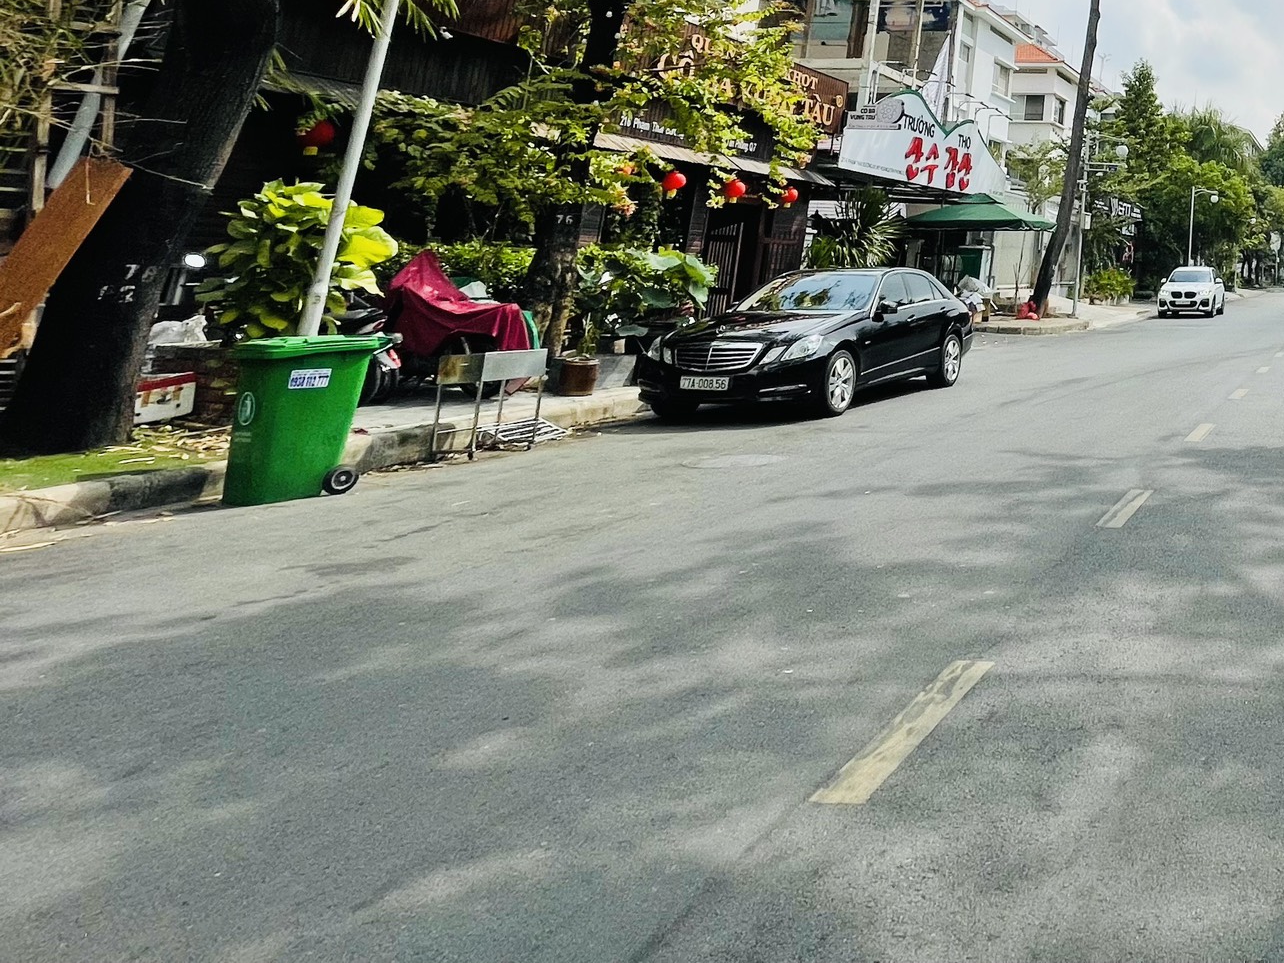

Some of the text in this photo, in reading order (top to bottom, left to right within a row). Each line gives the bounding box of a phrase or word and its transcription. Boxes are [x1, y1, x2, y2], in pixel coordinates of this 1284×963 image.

[799, 92, 836, 126] TÀU
[903, 114, 971, 152] TRƯỜNG THỌ
[681, 378, 727, 390] 77A-008.56
